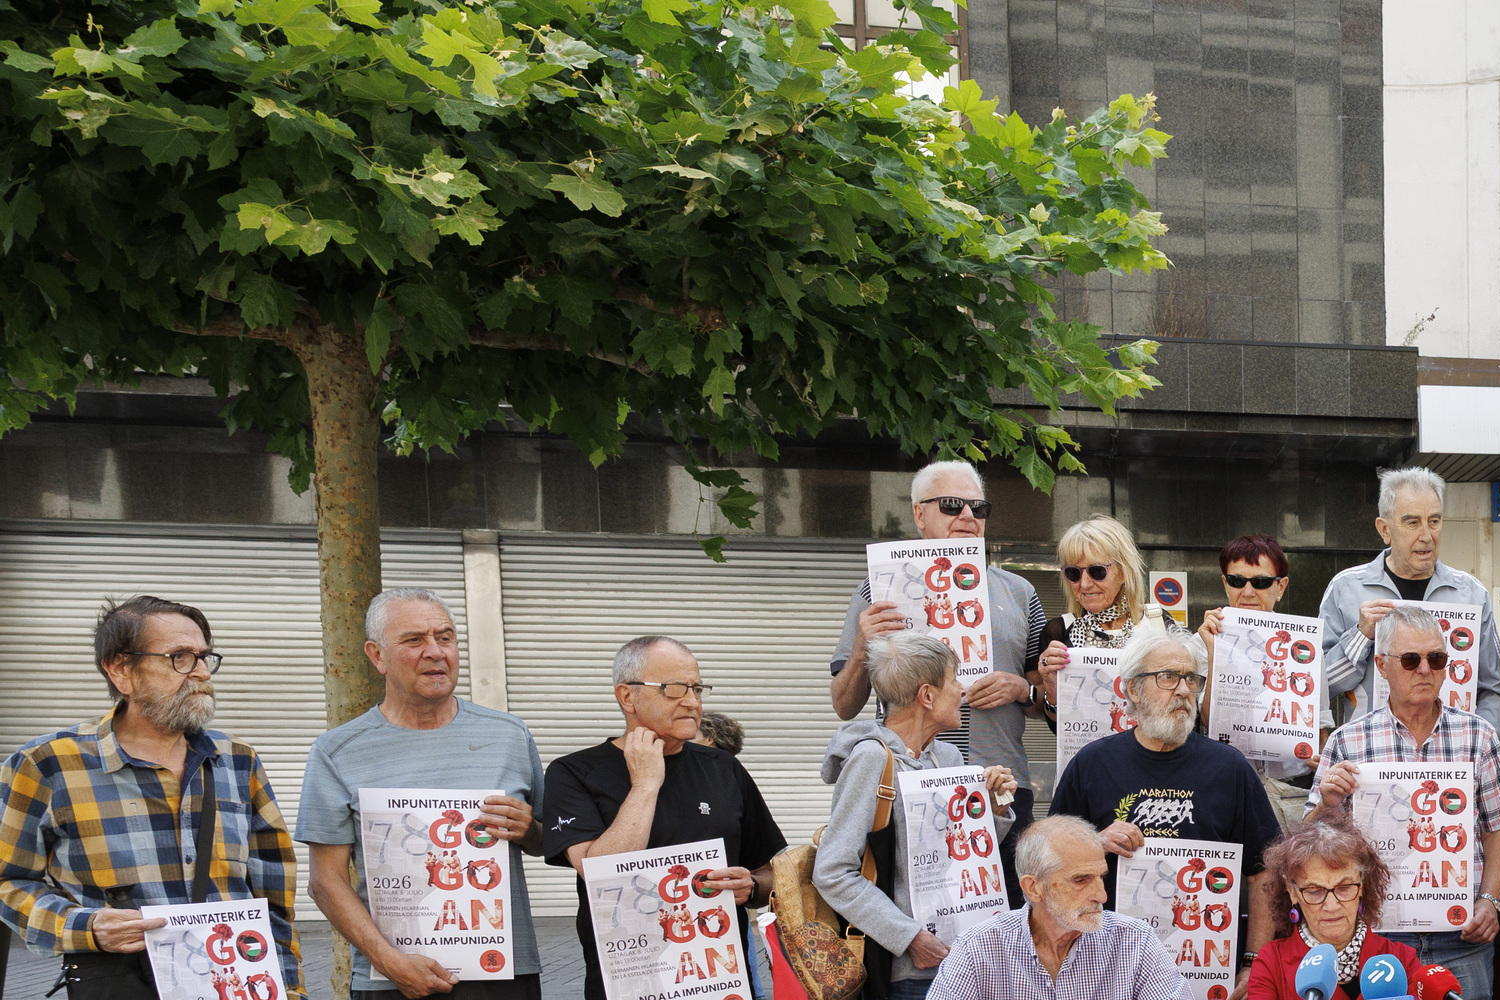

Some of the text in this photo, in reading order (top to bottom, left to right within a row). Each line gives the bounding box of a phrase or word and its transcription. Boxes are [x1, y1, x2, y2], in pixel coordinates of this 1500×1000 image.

[891, 547, 978, 559] INPUNITATERIK EZ
[1238, 616, 1317, 634] INPUNITATERIK EZ
[1219, 671, 1251, 686] 2026
[1267, 727, 1313, 739] IMPUNIDAD
[921, 774, 975, 789] INPUNITATERIK
[1379, 771, 1467, 779] INPUNITATERIK EZ
[1138, 788, 1194, 799] MARATHON
[388, 799, 480, 809] INPUNITATERIK
[1143, 827, 1179, 837] GREECE
[913, 850, 939, 866] 2026
[1146, 847, 1235, 859] INPUNITATERIK EZ
[616, 849, 719, 873] INPUNITATERIK EZ
[372, 875, 411, 889] 2026
[935, 908, 949, 916] NO
[955, 905, 965, 913] LA
[965, 898, 1004, 911] IMPUNIDAD
[167, 909, 261, 926] INPUNITATERIK EZ
[396, 937, 413, 945] NO
[424, 937, 438, 945] LA
[440, 936, 504, 945] IMPUNIDAD
[605, 934, 648, 953] 2026
[1299, 954, 1323, 969] tve
[658, 992, 666, 1000] A
[667, 990, 681, 999] LA
[682, 980, 741, 997] IMPUNIDAD
